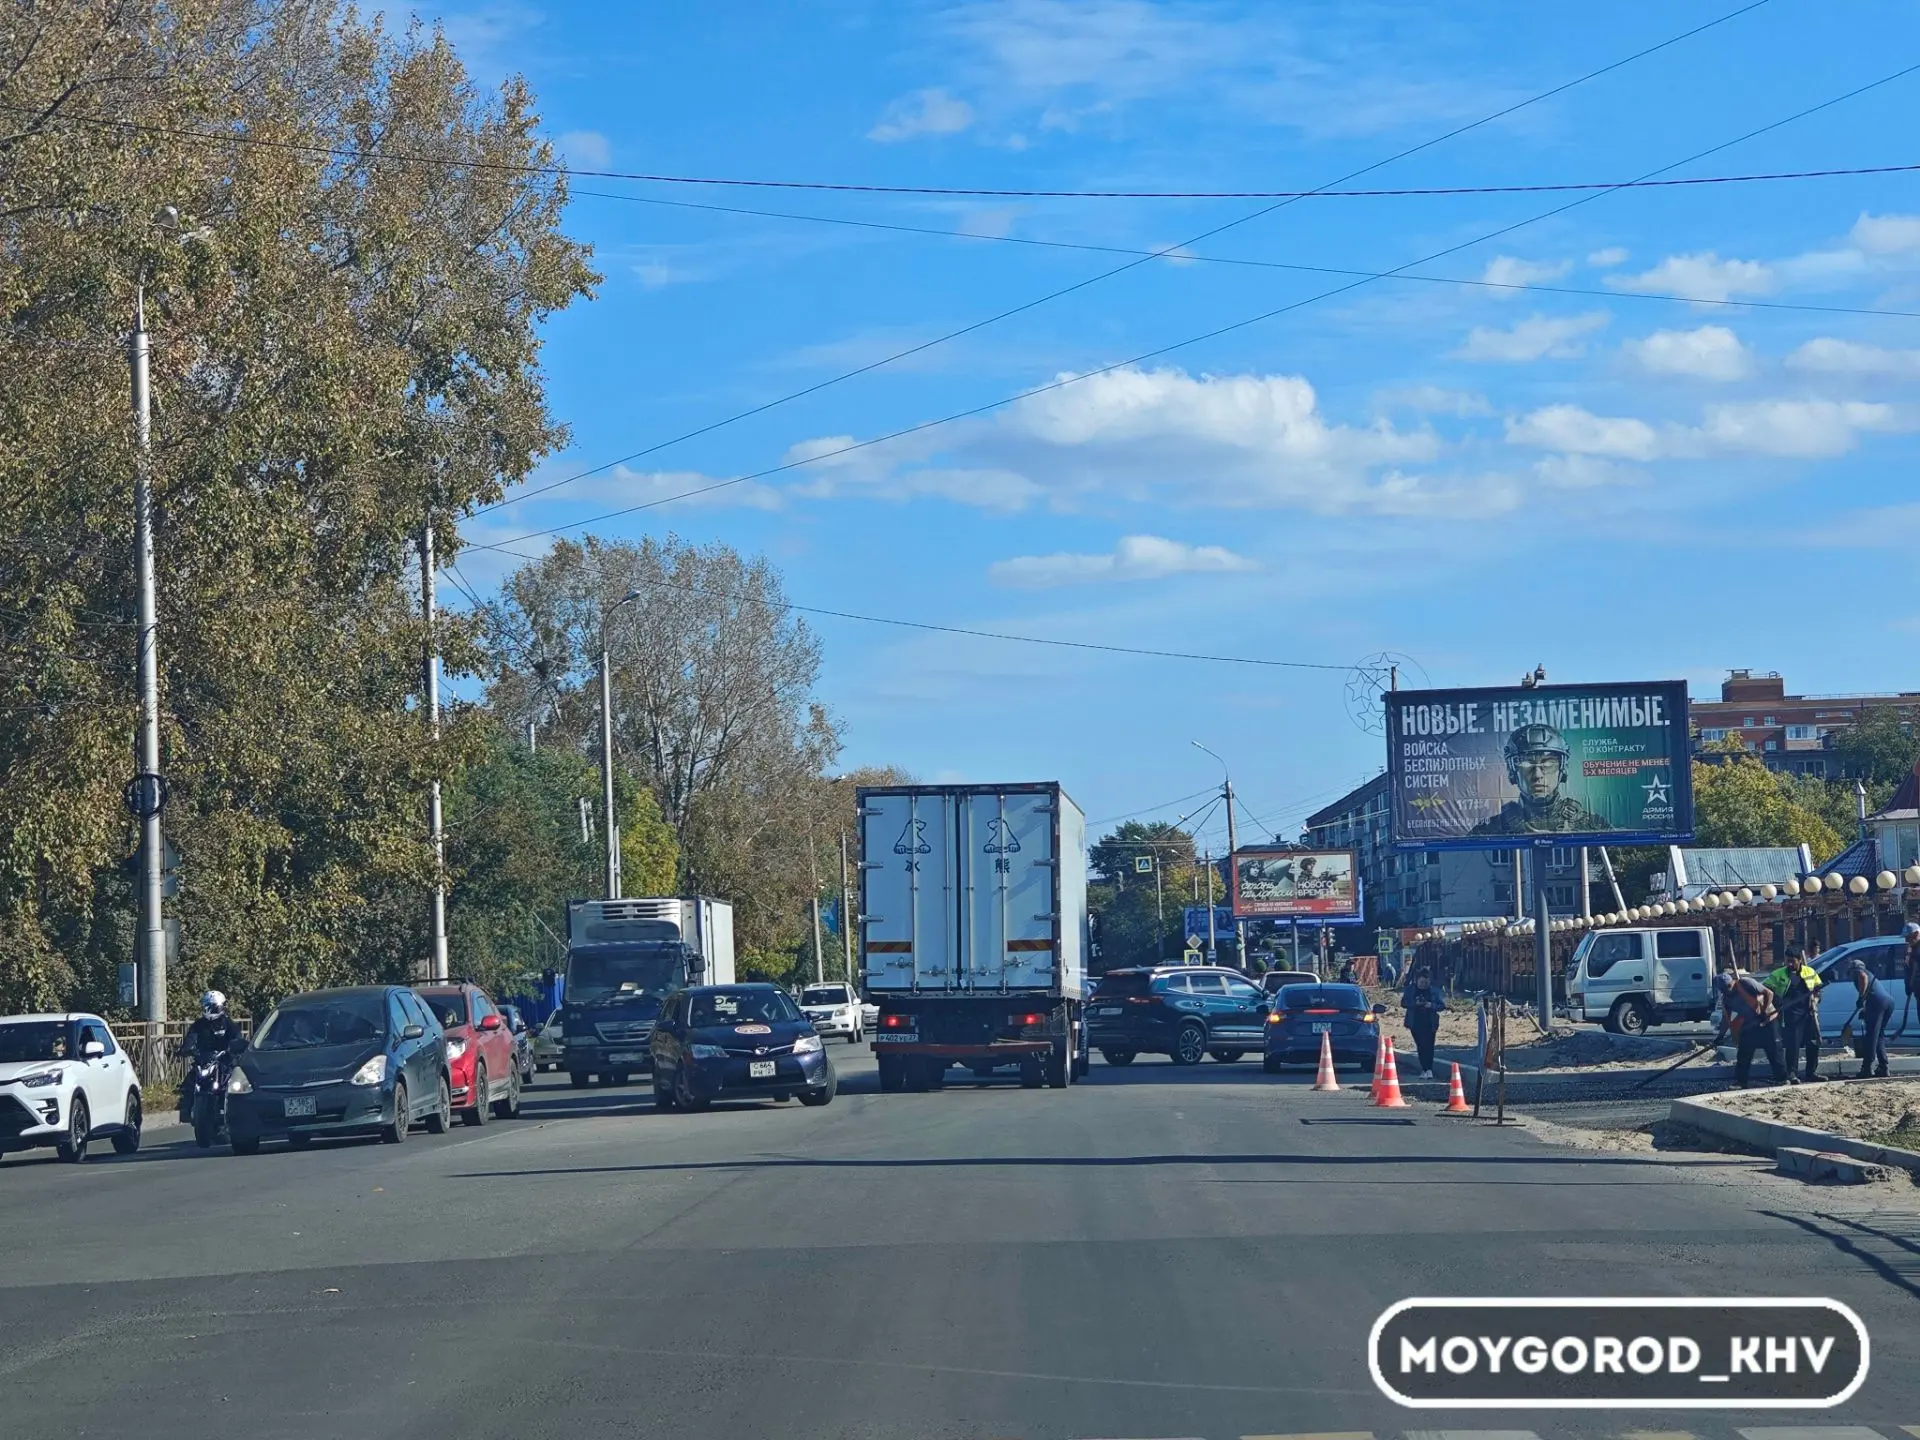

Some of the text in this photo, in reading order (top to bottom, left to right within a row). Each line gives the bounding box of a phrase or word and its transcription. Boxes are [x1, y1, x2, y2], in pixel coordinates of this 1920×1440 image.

[1402, 696, 1671, 735] НОВЫЕ. НЕЗАМЕНИМЫЕ.
[1582, 738, 1617, 746] СЛУЖБА
[1403, 740, 1448, 756] ВОЙСКА
[1583, 744, 1646, 754] ПО КОНТРАКТУ
[1404, 756, 1486, 773] БЕСПИЛОТНЫХ
[1583, 760, 1628, 769] ОБУЧЕНИЕ
[1641, 758, 1670, 766] МЕНЕЕ
[1598, 767, 1638, 776] МЕСЯЦЕВ
[1405, 774, 1449, 788] СИСТЕМ
[1642, 806, 1674, 814] АРМИЯ
